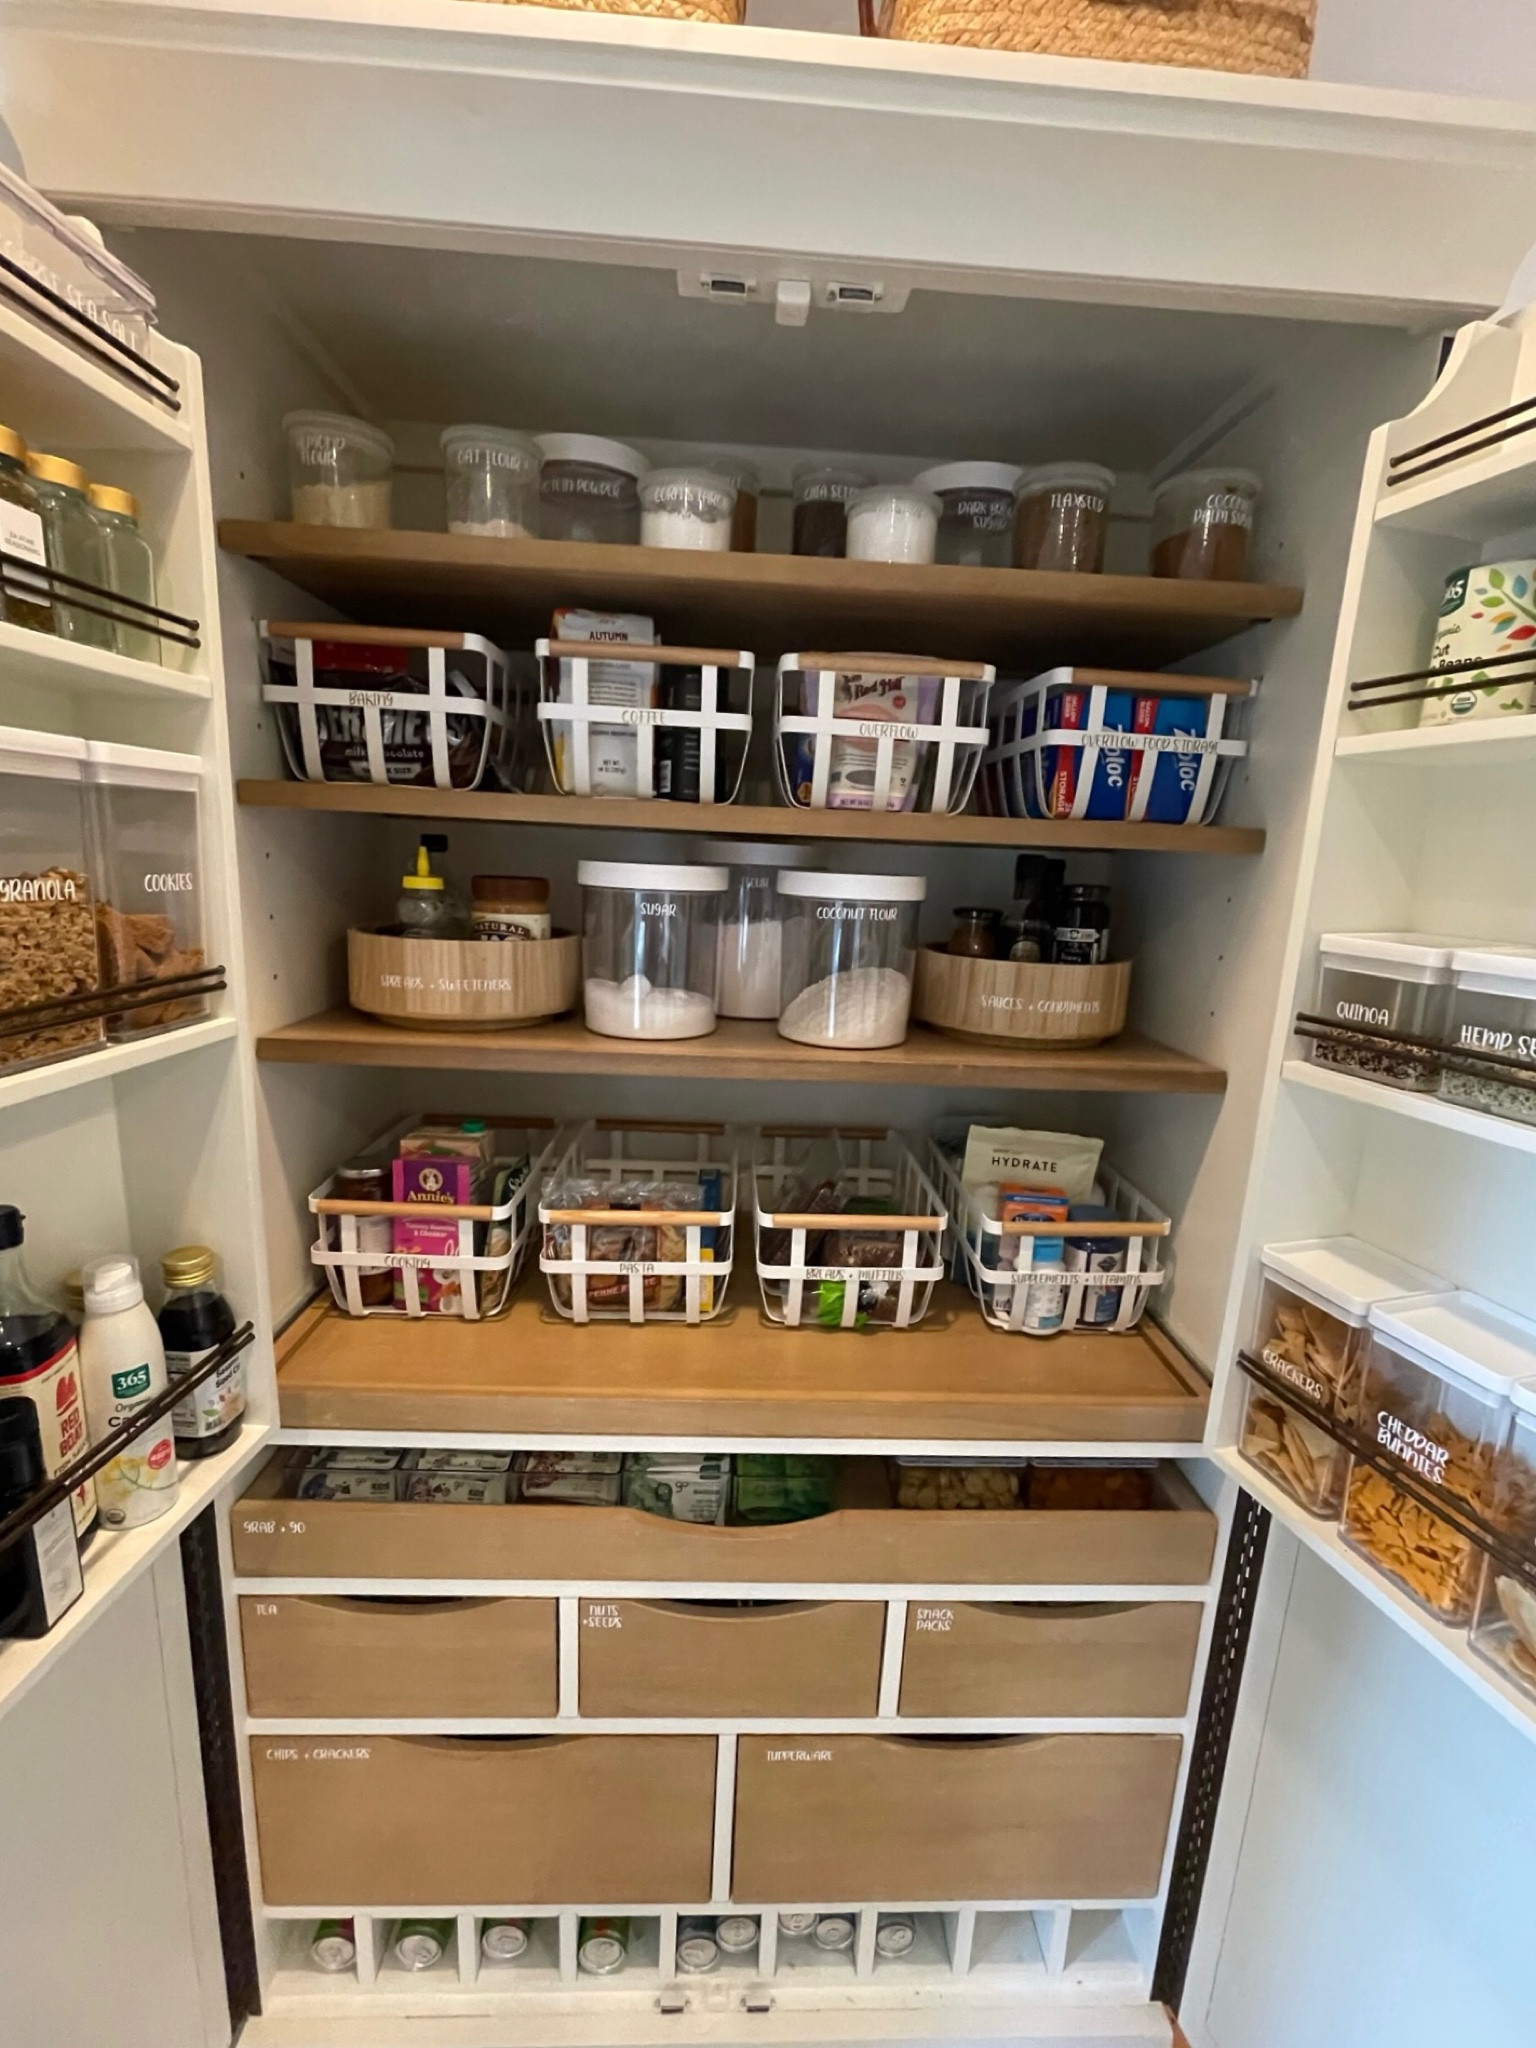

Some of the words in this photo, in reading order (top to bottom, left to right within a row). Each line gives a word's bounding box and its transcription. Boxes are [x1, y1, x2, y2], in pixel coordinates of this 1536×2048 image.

[957, 501, 987, 515] DARK
[1050, 493, 1105, 513] FLAXSEED
[589, 631, 629, 642] AUTUMN
[349, 692, 394, 706] BAKING
[621, 710, 667, 724] COFFEE
[859, 723, 918, 739] OVERFLOW
[1082, 734, 1136, 748] OVERFLOW
[1143, 737, 1171, 749] FOOD
[1172, 739, 1221, 755] STORAGE
[0, 878, 77, 902] GRANOLA
[144, 873, 193, 892] COOKIES
[640, 903, 677, 917] SUGAR
[816, 906, 865, 920] COCONUT
[869, 907, 898, 921] FLOUR
[981, 995, 1024, 1011] SAUCES
[1336, 1000, 1389, 1026] QUINOA
[1460, 1024, 1513, 1050] HEMP
[991, 1156, 1058, 1173] HYDRATE
[407, 1191, 455, 1204] Annie's
[384, 1256, 431, 1269] COOKING
[619, 1263, 655, 1274] PASTA
[1010, 1273, 1080, 1285] SUPPLEMENTS
[1092, 1275, 1143, 1286] VITAMINS
[116, 1369, 148, 1391] 365
[1262, 1347, 1324, 1400] CRACKERS
[61, 1407, 80, 1438] RED
[59, 1421, 82, 1458] BOAT
[1376, 1410, 1449, 1467] CHEDDAR
[1376, 1430, 1445, 1485] BUNNIES
[256, 1605, 277, 1615] TEA
[588, 1605, 620, 1616] NUTS
[916, 1608, 954, 1621] SNACK
[915, 1620, 952, 1632] PACKS
[266, 1748, 298, 1760] CHIPS
[312, 1748, 372, 1760] CRACKERS
[766, 1750, 834, 1762] TUPPERWARE
